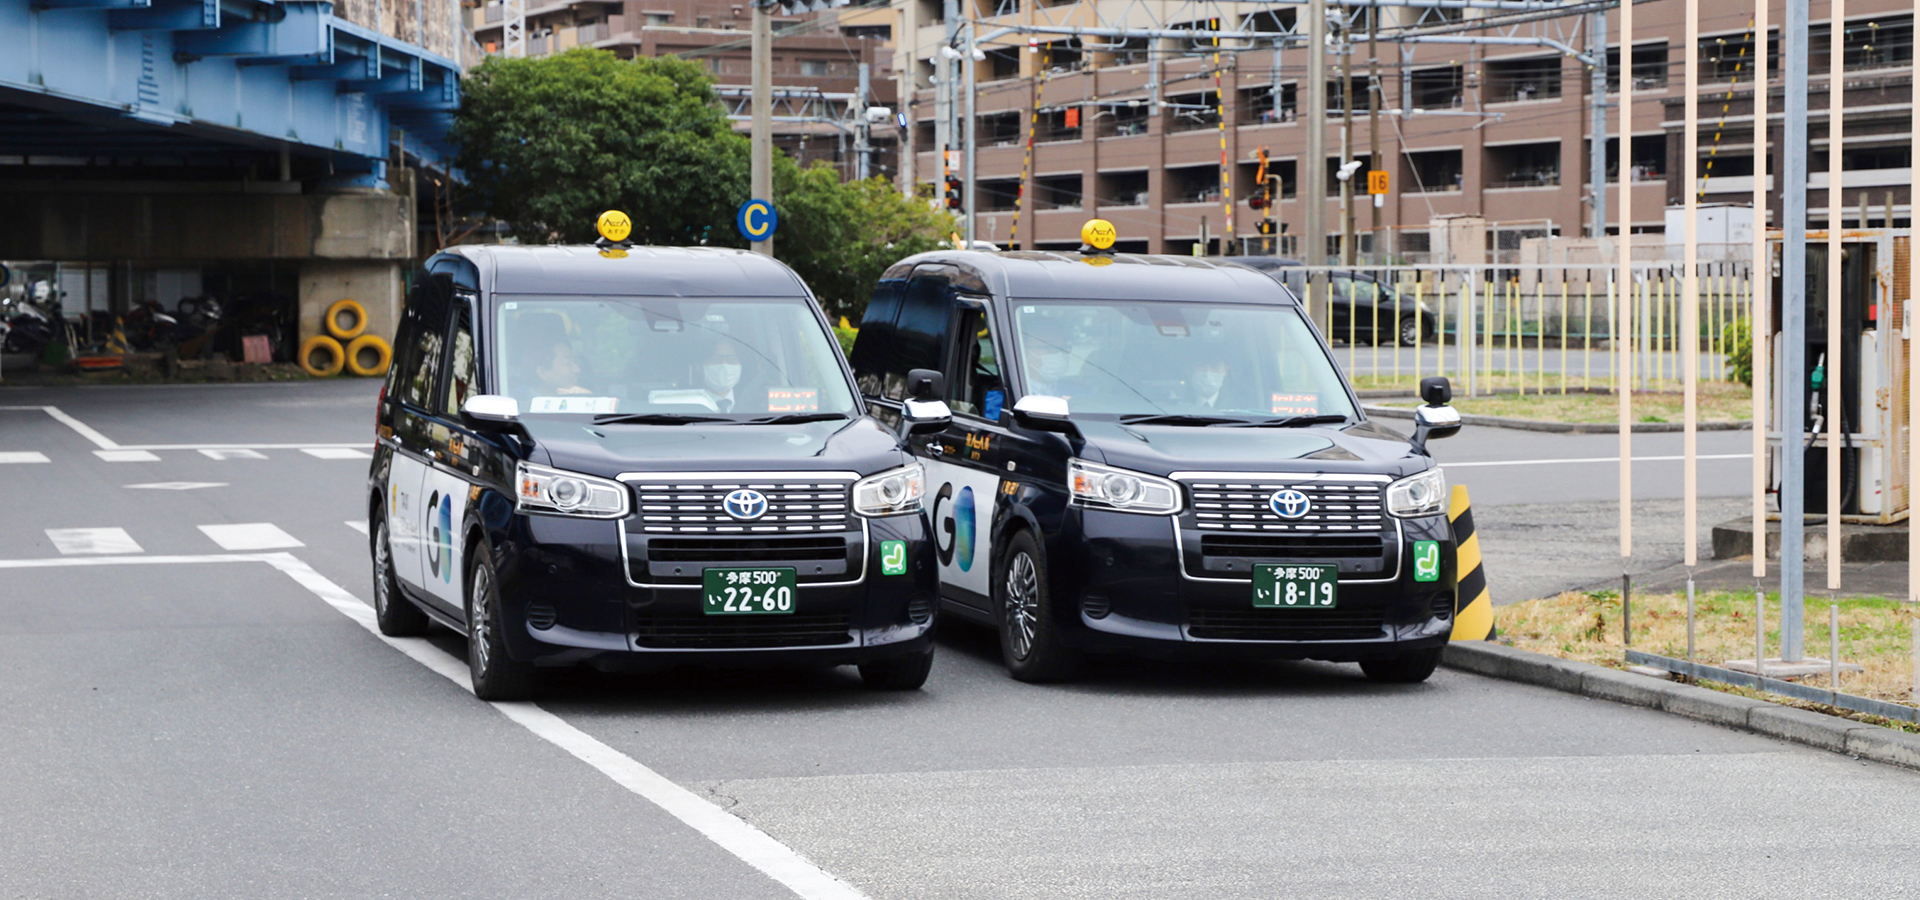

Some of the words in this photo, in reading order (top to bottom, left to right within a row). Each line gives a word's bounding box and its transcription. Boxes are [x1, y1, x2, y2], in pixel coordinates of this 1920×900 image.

[1372, 175, 1387, 190] 16
[744, 203, 769, 236] C
[426, 489, 452, 584] GO
[931, 481, 976, 573] GO
[723, 586, 791, 612] 22-60
[1274, 581, 1333, 606] 18-19
